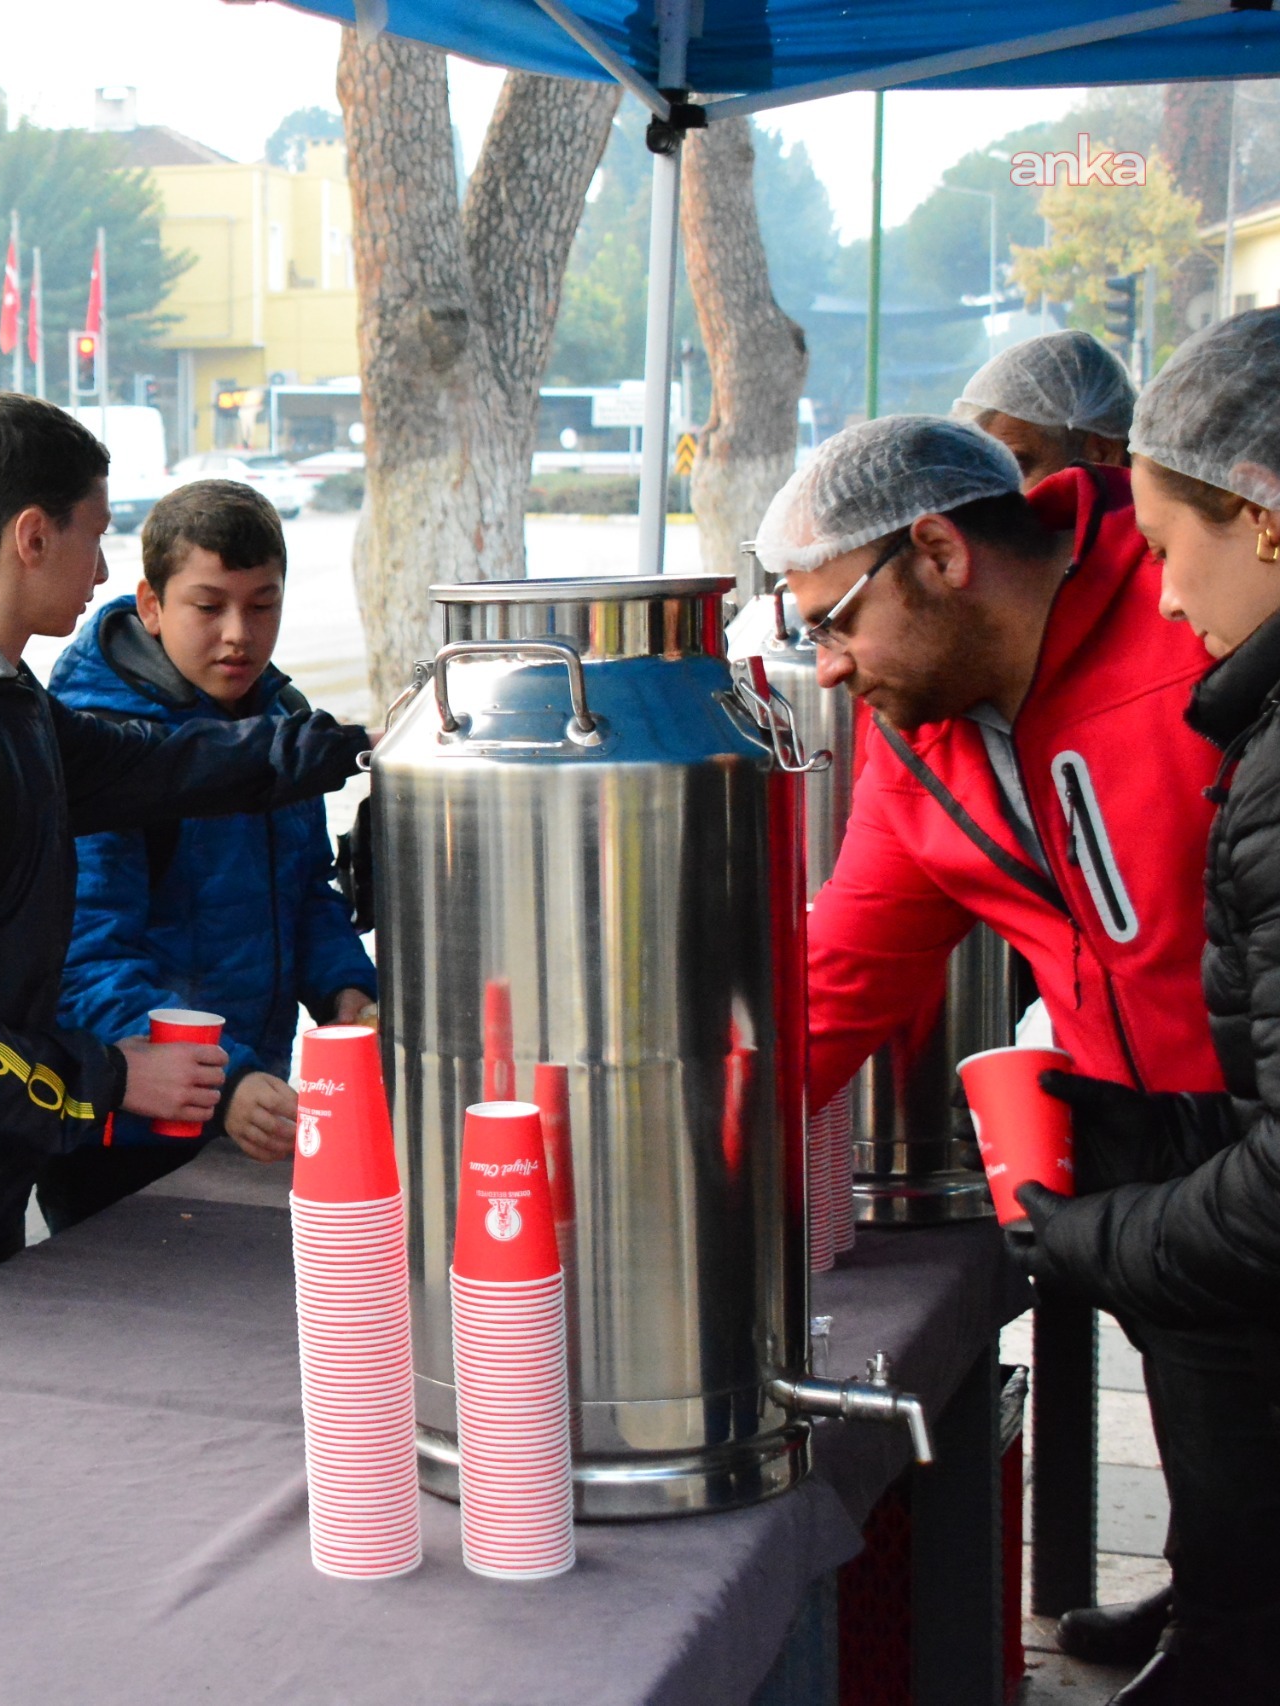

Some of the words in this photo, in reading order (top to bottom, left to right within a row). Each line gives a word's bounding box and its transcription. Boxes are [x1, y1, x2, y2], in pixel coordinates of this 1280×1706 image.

[307, 1078, 346, 1096] Afiyet
[469, 1161, 499, 1178] Olsun
[500, 1158, 539, 1176] Afiyet
